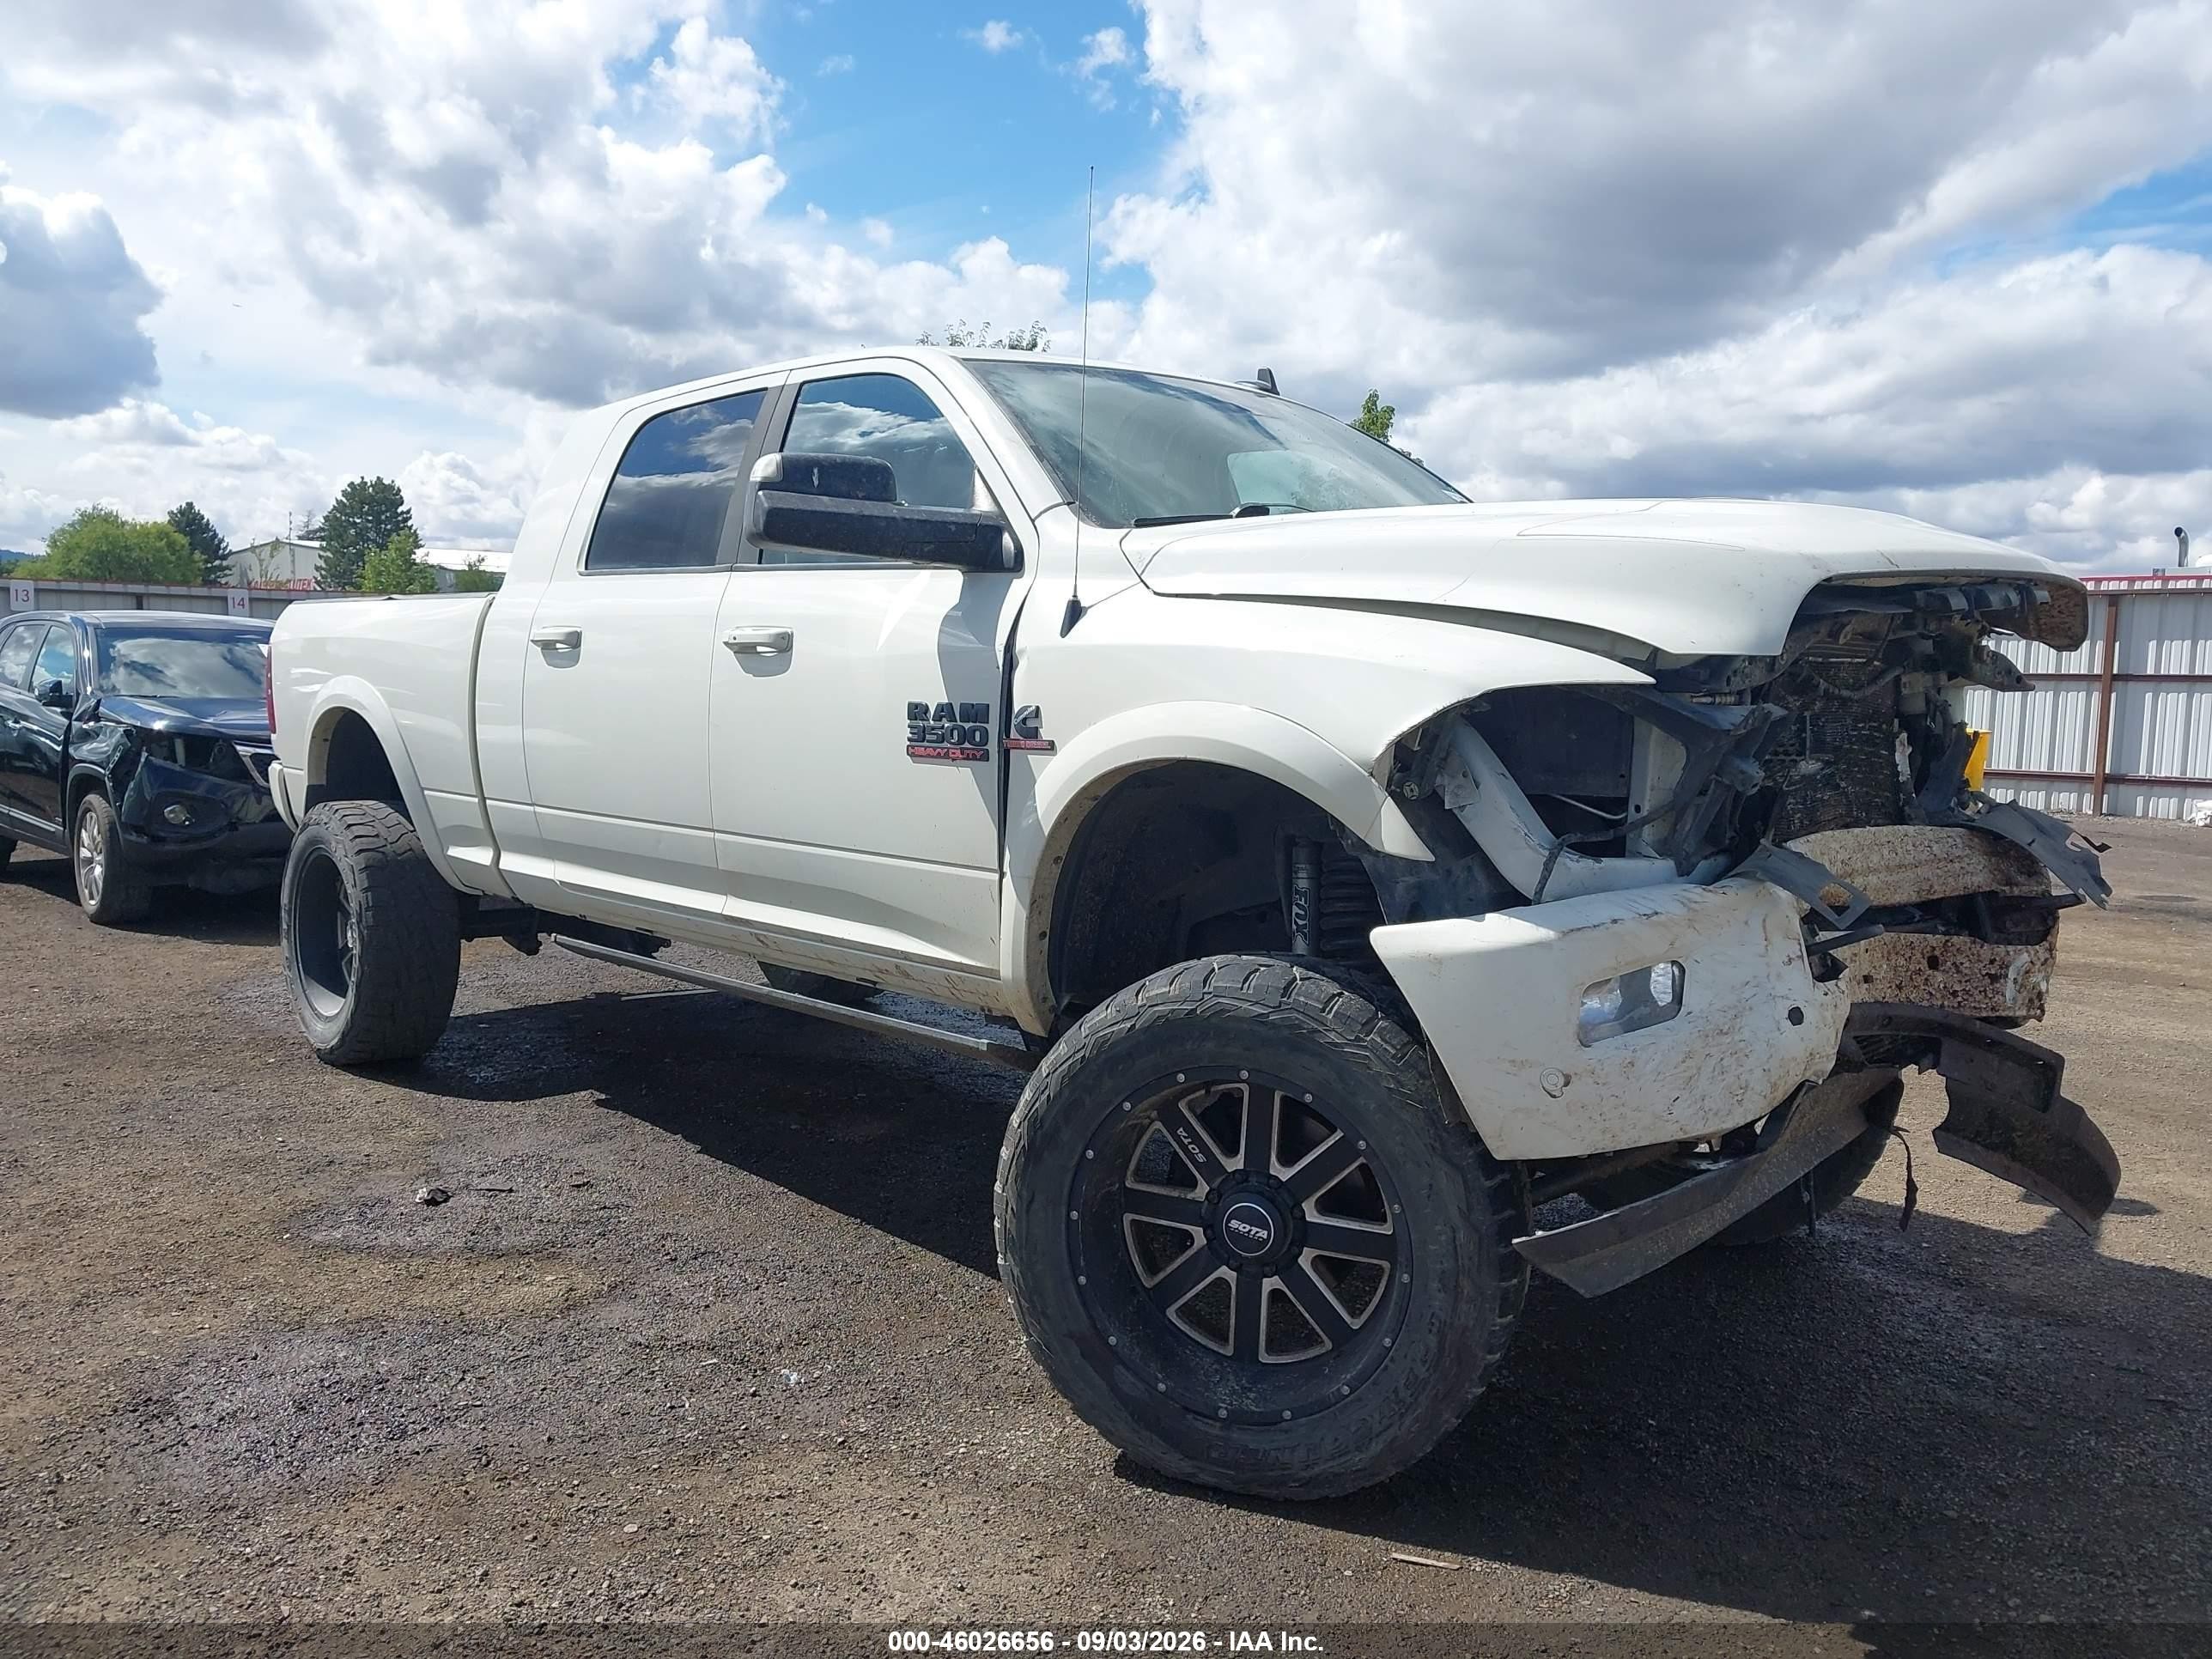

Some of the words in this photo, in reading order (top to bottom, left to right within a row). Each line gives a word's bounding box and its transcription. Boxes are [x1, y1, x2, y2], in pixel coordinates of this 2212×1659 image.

[15, 589, 30, 603] 13
[232, 597, 246, 610] 14
[907, 702, 989, 724] RAM
[907, 723, 989, 747] 3500
[908, 746, 947, 757] HEAVY
[948, 748, 984, 759] DUTY
[1292, 884, 1310, 945] FOX
[1176, 1127, 1207, 1163] SOTA
[1227, 1219, 1268, 1240] SOTA
